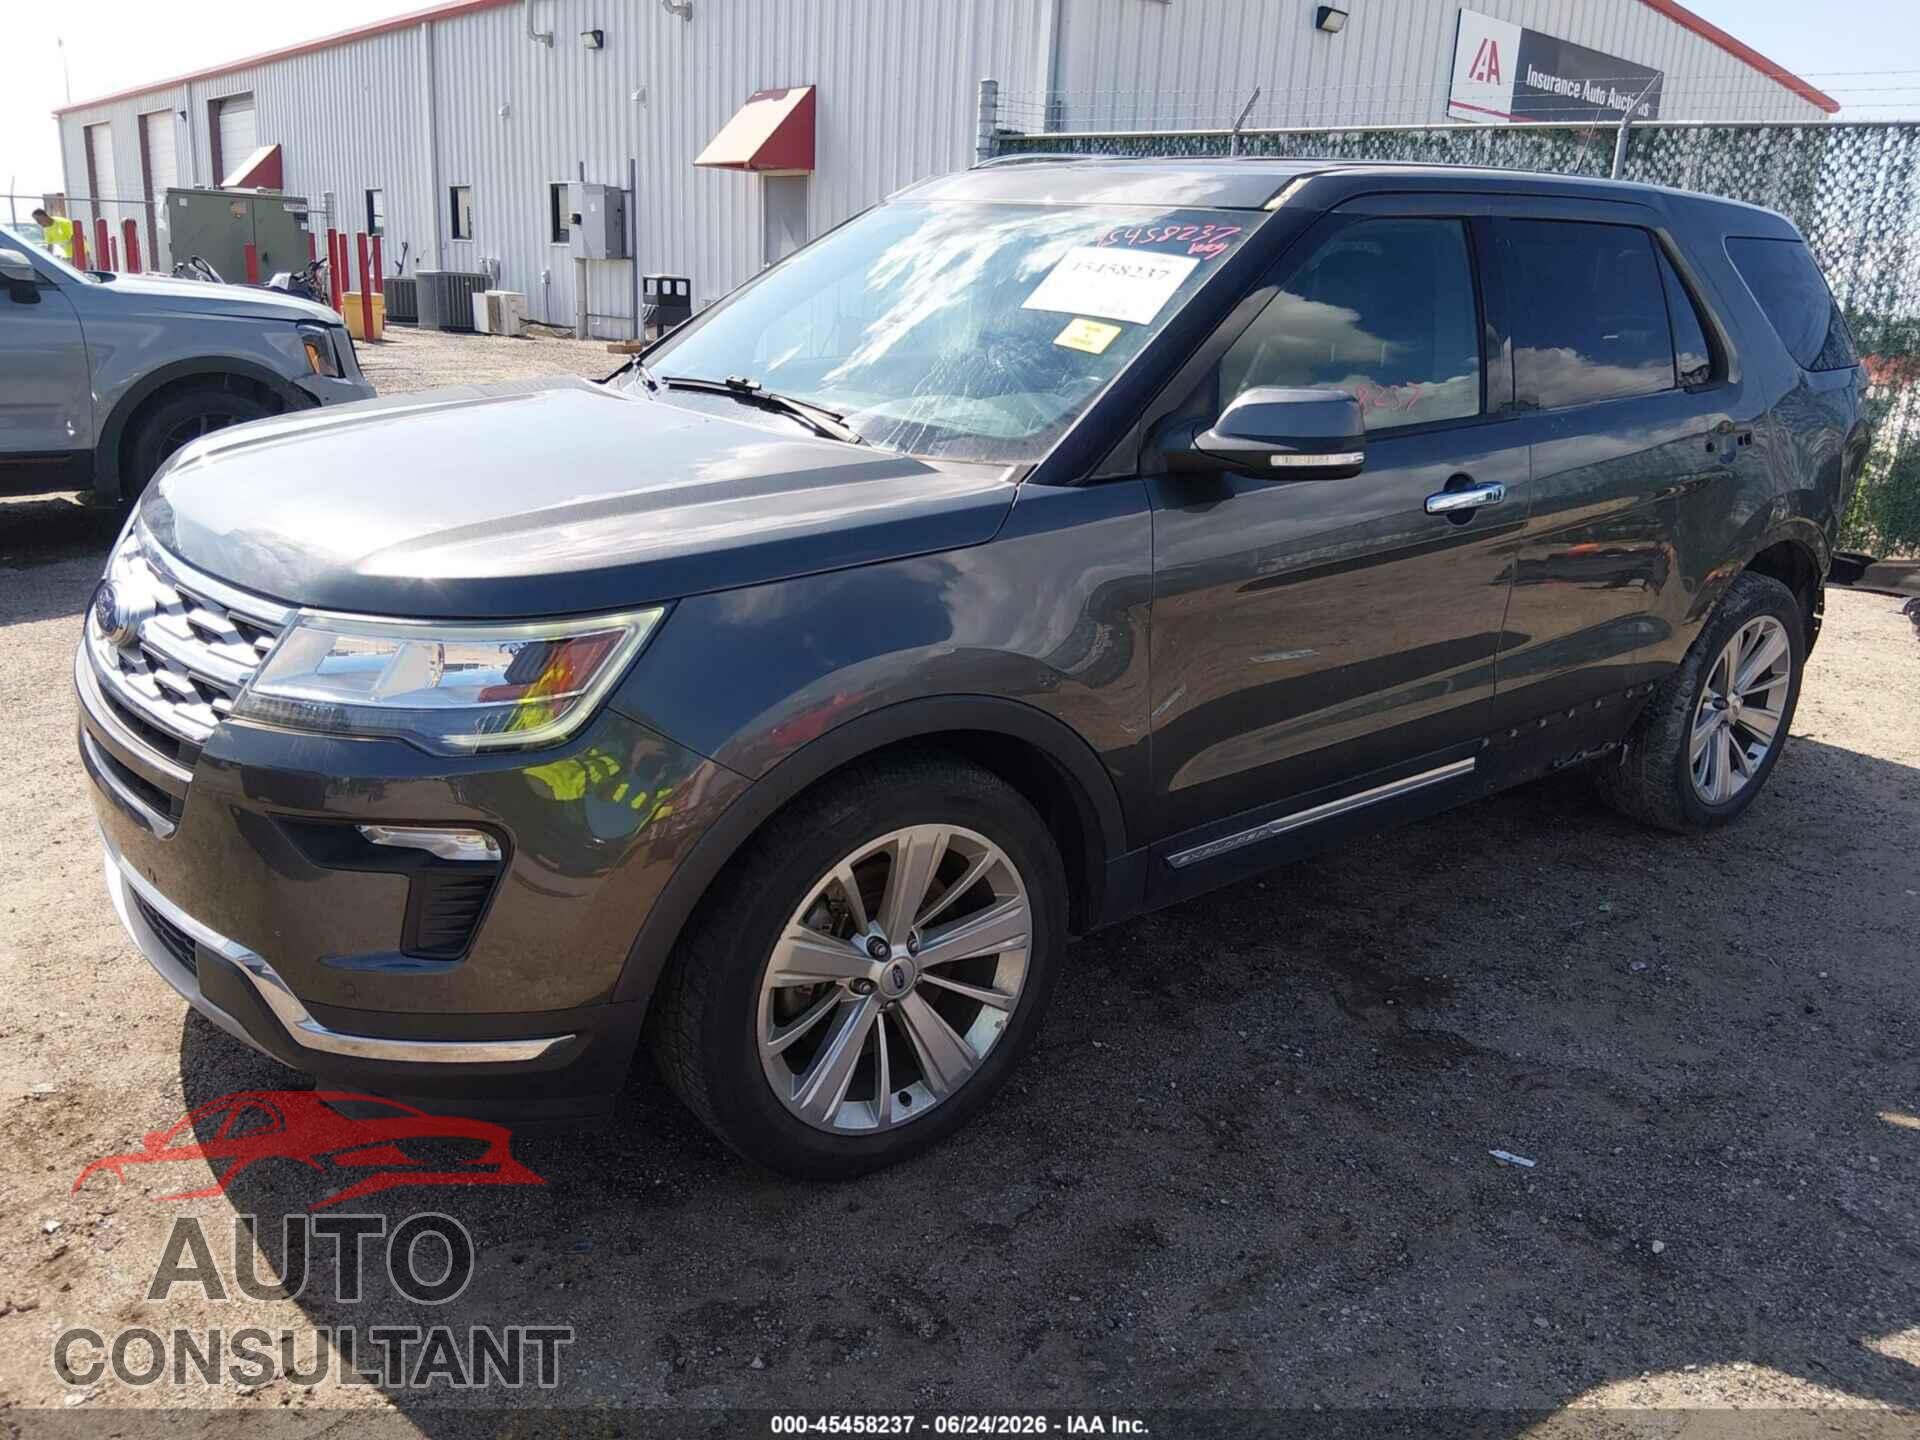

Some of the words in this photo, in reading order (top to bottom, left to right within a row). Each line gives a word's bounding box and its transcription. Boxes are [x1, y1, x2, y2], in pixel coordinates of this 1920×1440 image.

[1526, 63, 1580, 98] Insurance
[1582, 80, 1606, 106] Auto
[1606, 87, 1650, 117] Auctins
